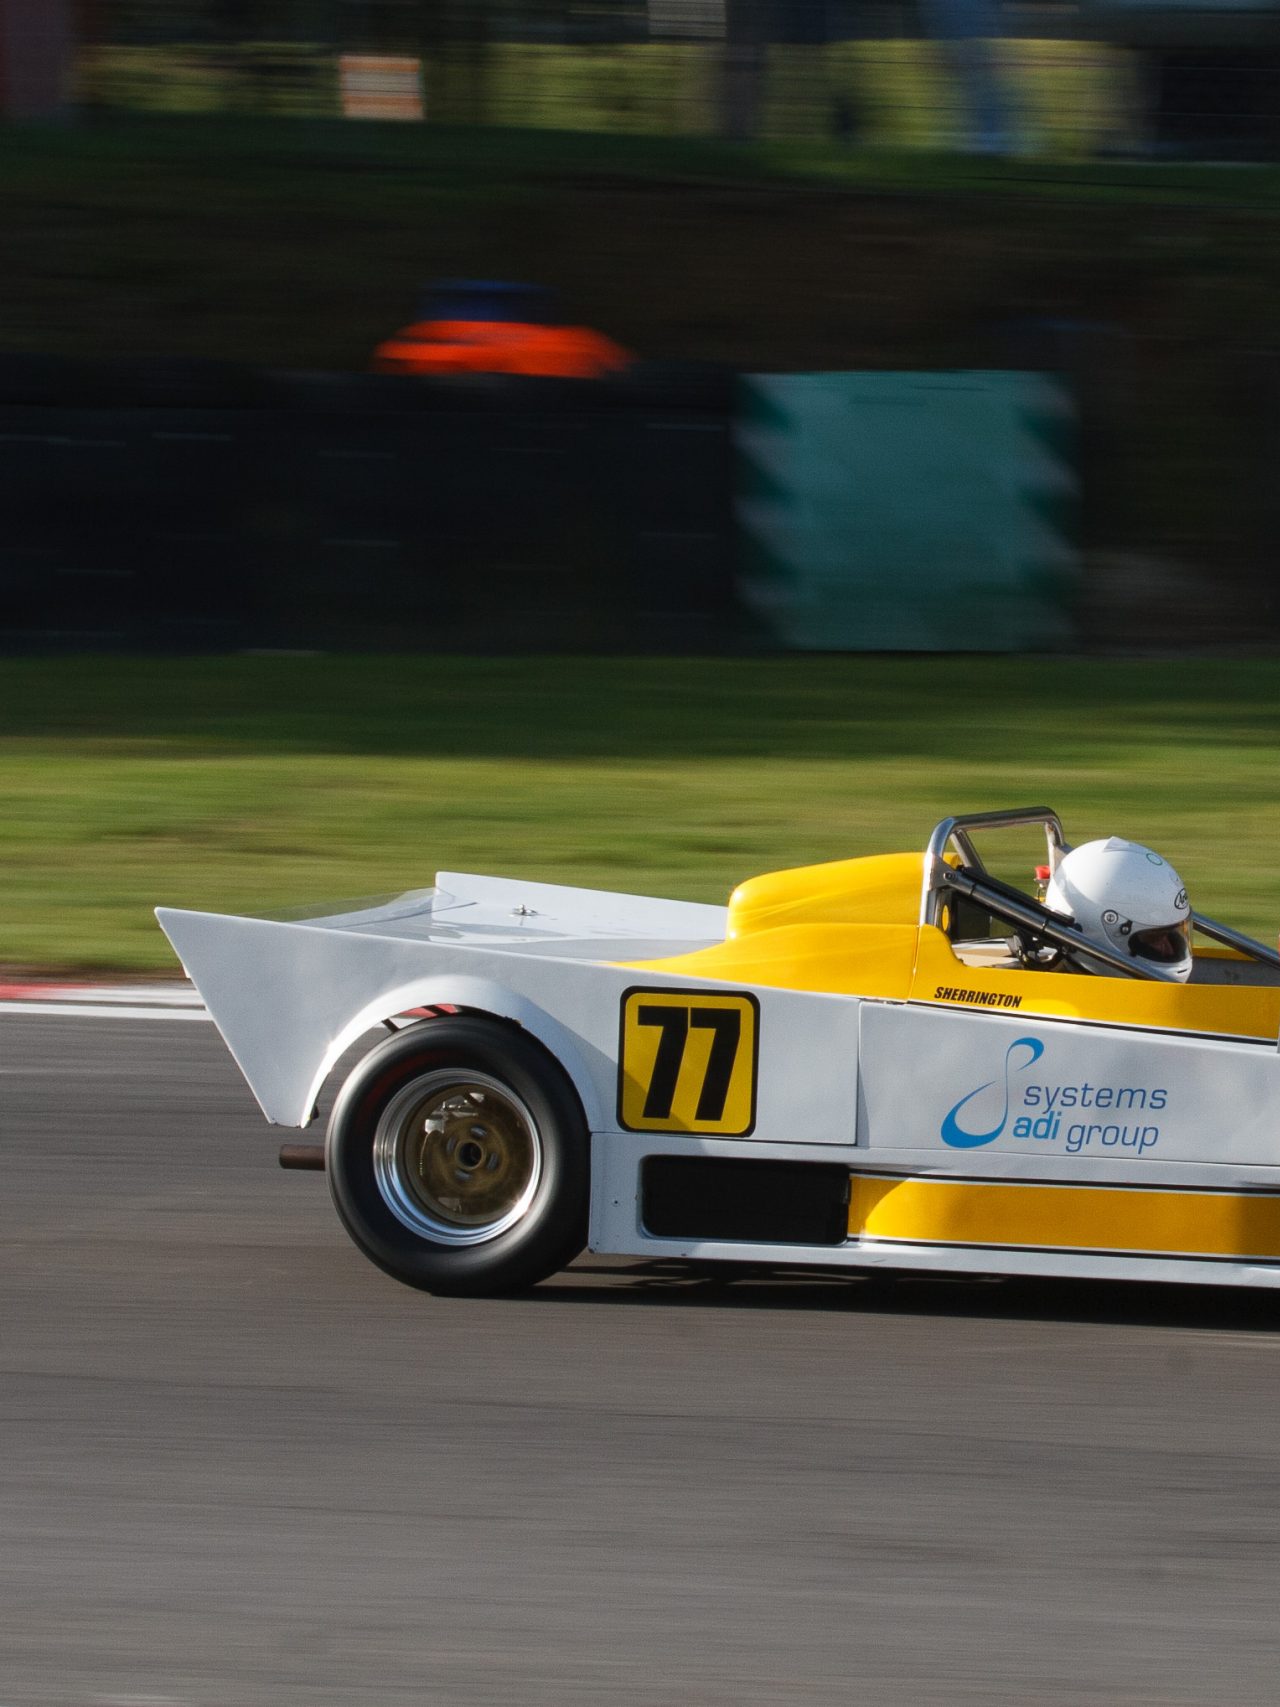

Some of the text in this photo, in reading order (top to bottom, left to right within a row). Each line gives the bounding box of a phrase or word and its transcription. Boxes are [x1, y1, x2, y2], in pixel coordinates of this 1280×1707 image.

[934, 986, 1023, 1009] SHERRINGTON
[637, 1004, 741, 1122] 77
[1023, 1082, 1169, 1115] systems
[1012, 1110, 1160, 1155] adi group
